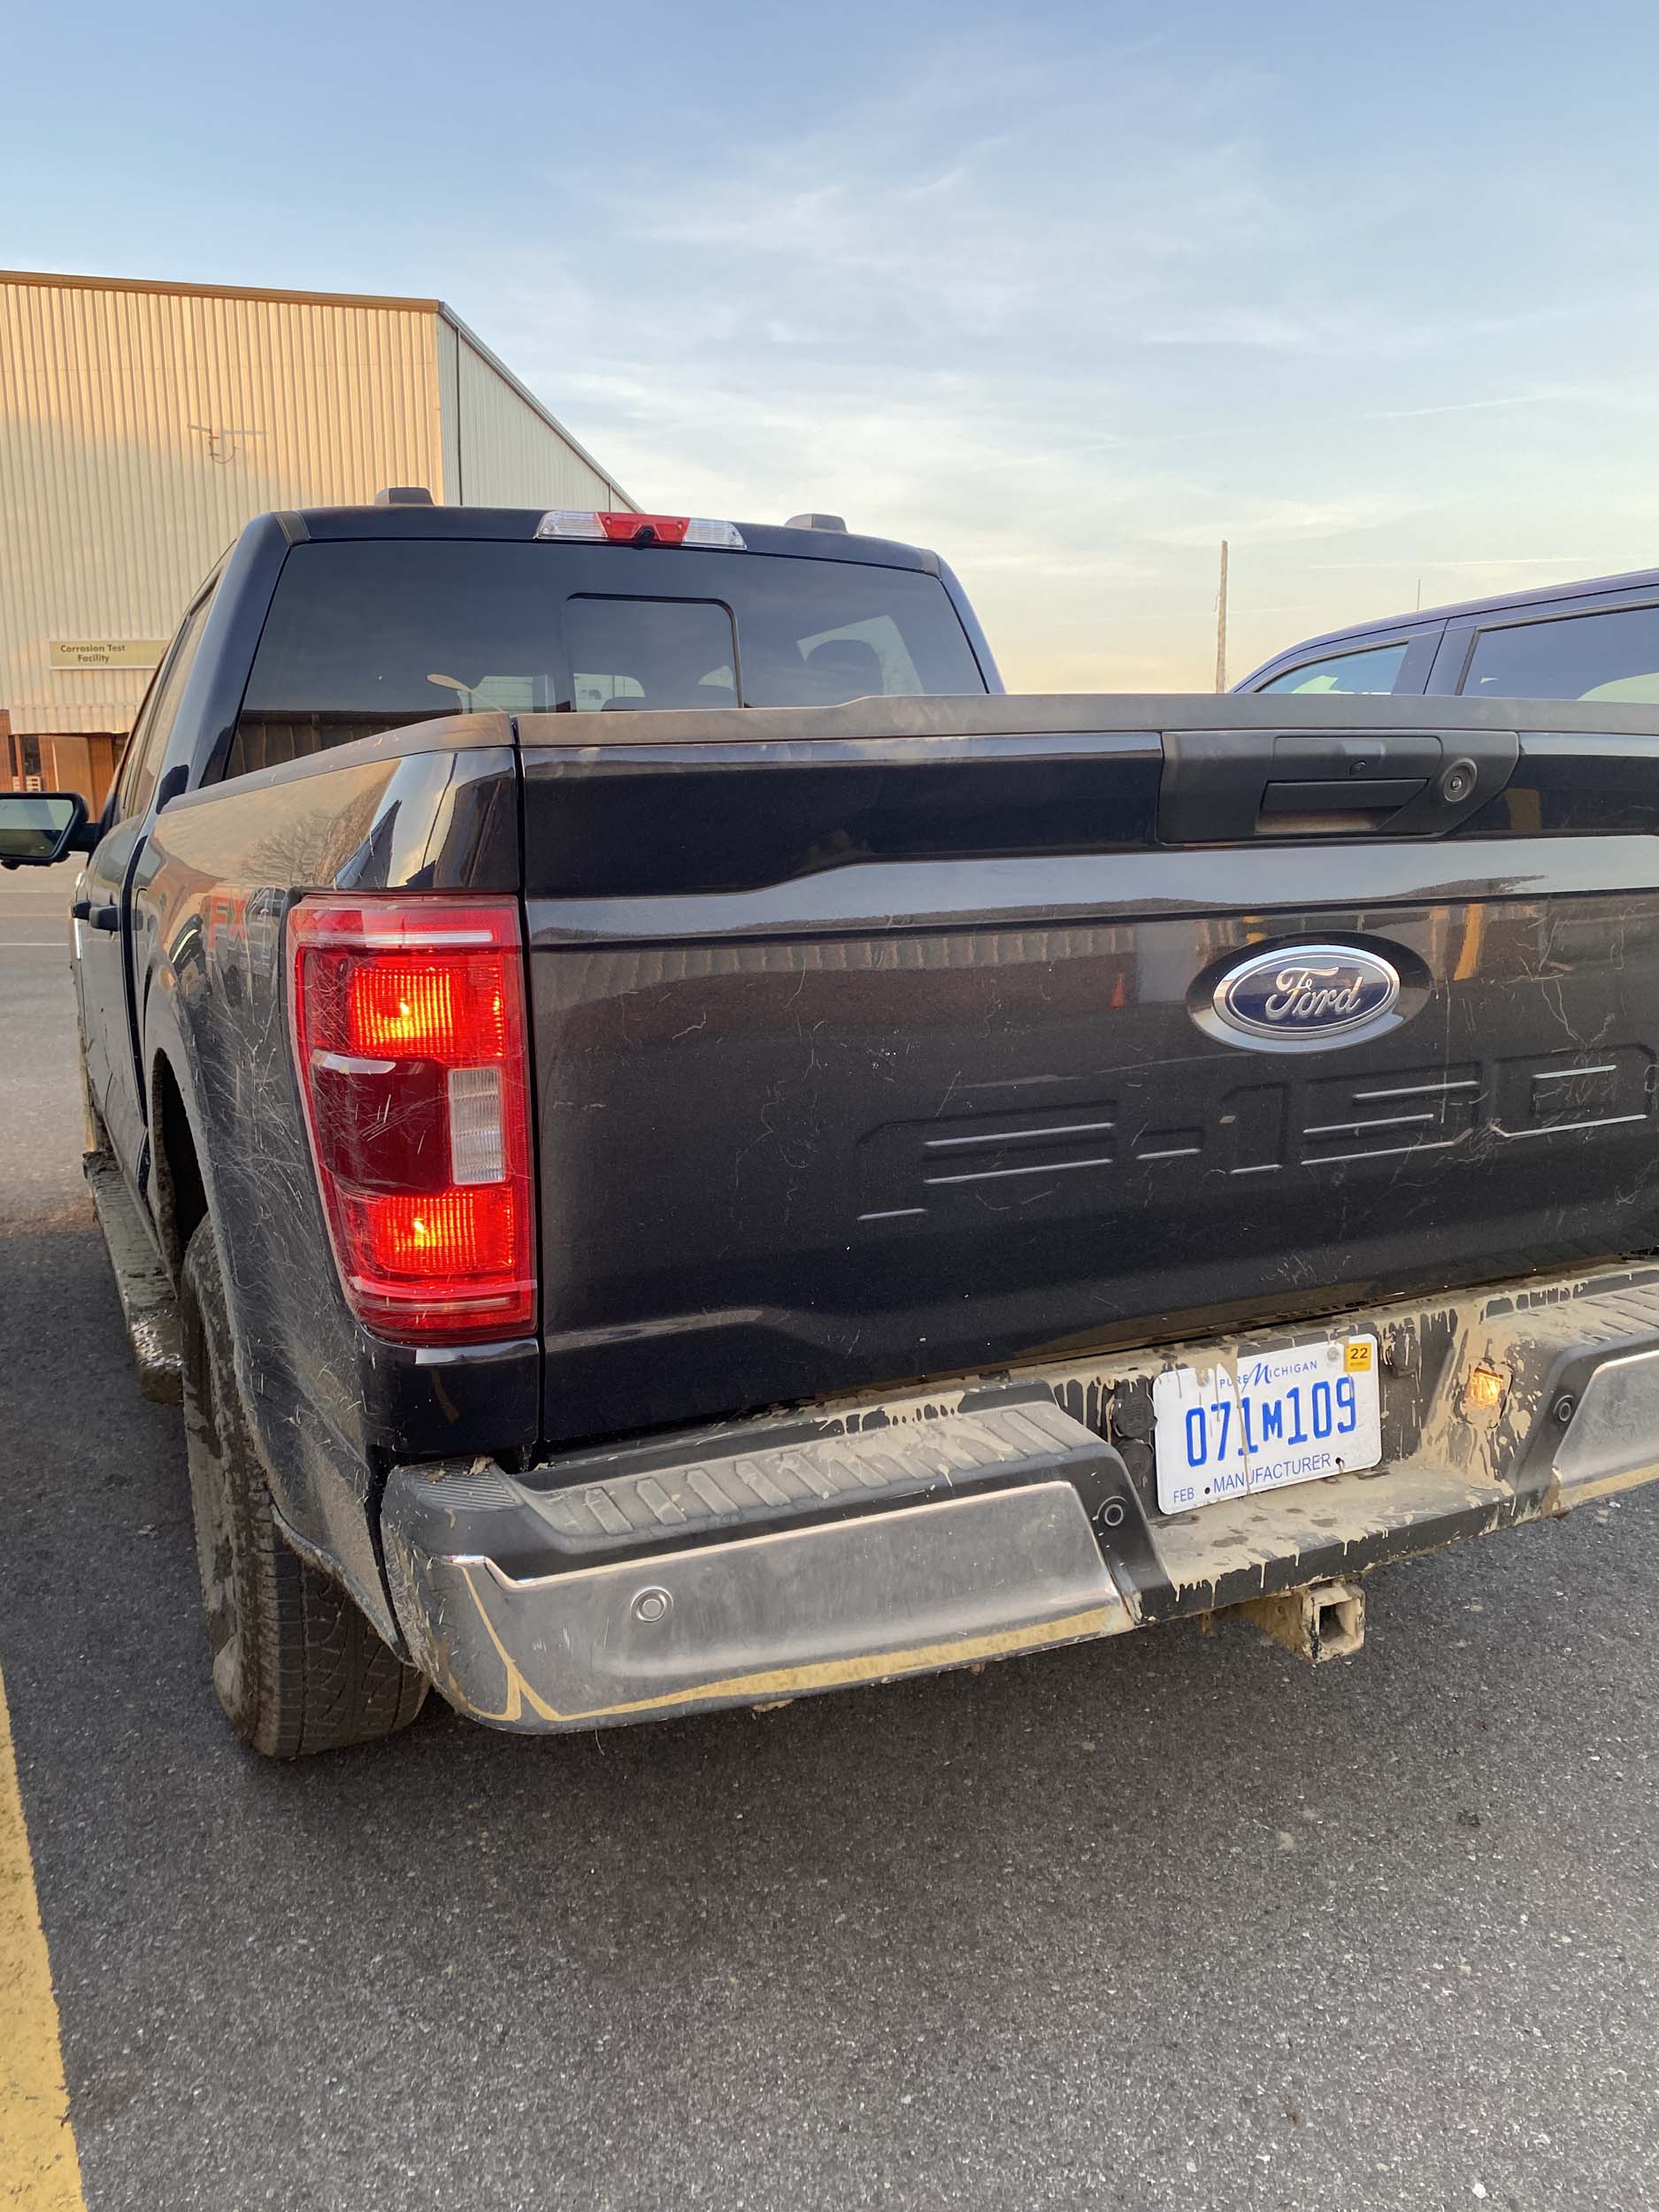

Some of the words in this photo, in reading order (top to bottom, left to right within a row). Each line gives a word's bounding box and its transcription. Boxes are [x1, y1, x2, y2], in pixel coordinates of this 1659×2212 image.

[60, 644, 105, 653] Corrosion
[78, 655, 110, 664] Facility
[1265, 966, 1363, 1020] Ford
[1350, 1348, 1368, 1360] 22
[1219, 1374, 1249, 1388] PURE
[1241, 1360, 1318, 1394] MICHIGAN
[1186, 1376, 1356, 1468] 071M109
[1173, 1487, 1194, 1503] FEB
[1213, 1453, 1332, 1494] MANUFACTURER
